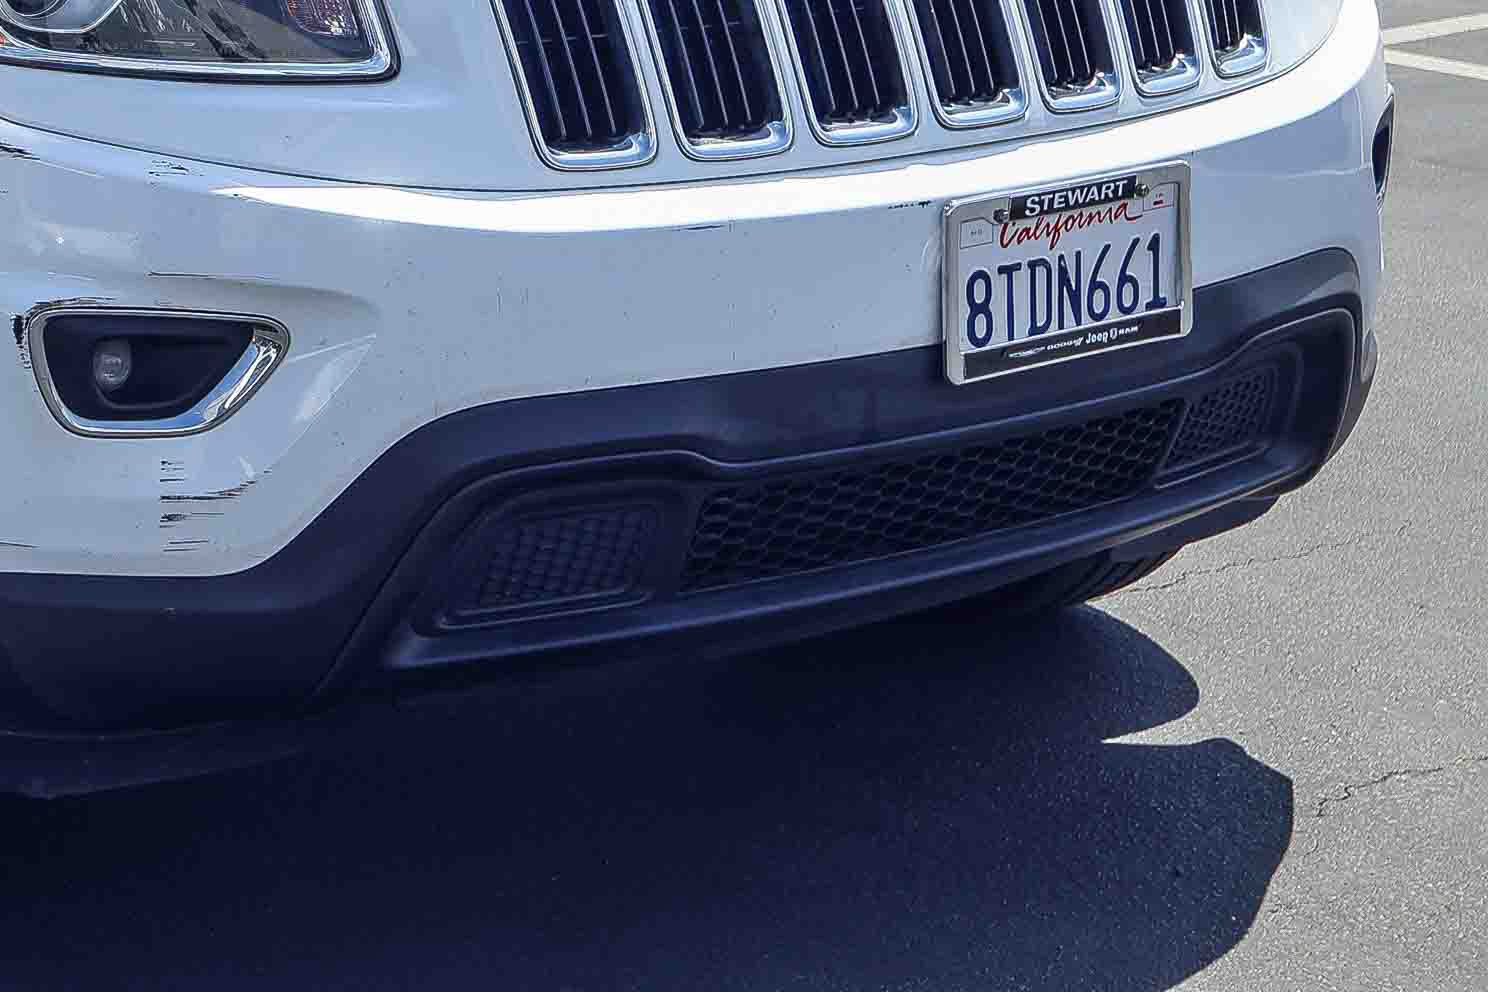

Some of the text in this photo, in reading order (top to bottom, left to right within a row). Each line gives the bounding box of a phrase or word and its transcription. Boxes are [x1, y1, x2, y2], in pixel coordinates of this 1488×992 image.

[1024, 179, 1128, 217] STEWART
[998, 200, 1142, 250] California
[966, 232, 1168, 349] 8TDN661
[1085, 330, 1109, 345] Jeep
